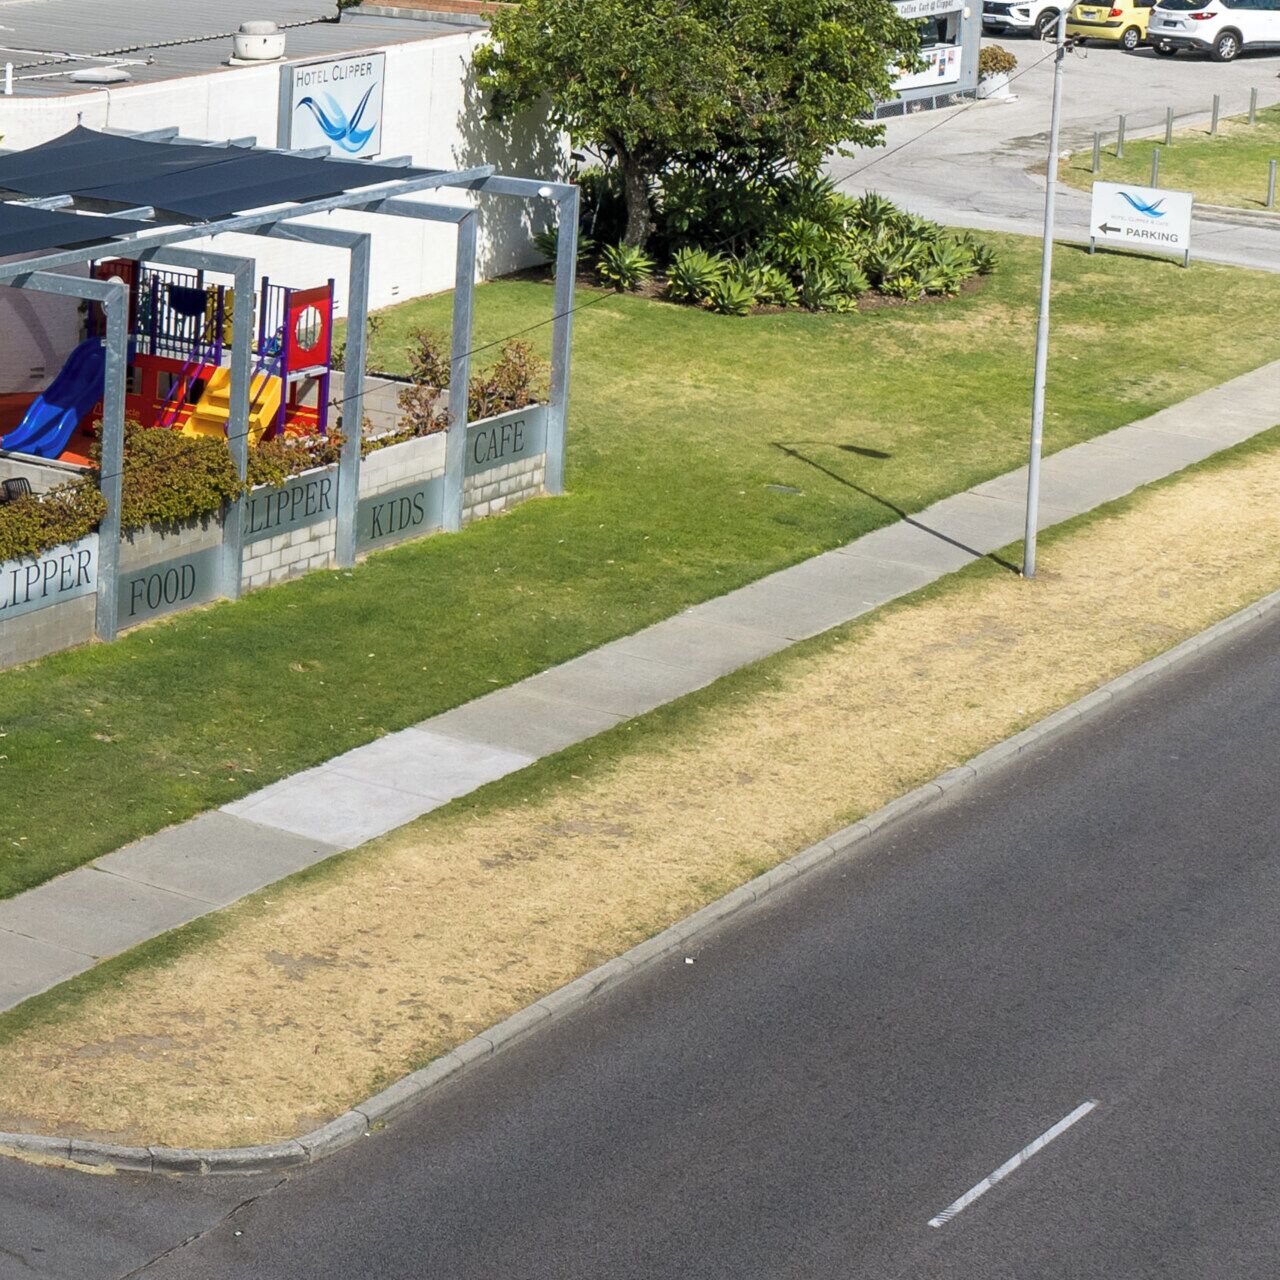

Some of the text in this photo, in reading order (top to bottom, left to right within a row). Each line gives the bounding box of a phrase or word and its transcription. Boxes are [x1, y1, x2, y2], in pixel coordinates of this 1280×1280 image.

[296, 62, 372, 87] HOTEL CLIPPER
[1126, 228, 1178, 242] PARKING
[474, 420, 526, 464] CAFE
[244, 477, 332, 536] LIPPER
[370, 491, 425, 539] KIDS
[129, 564, 196, 617] FOOD
